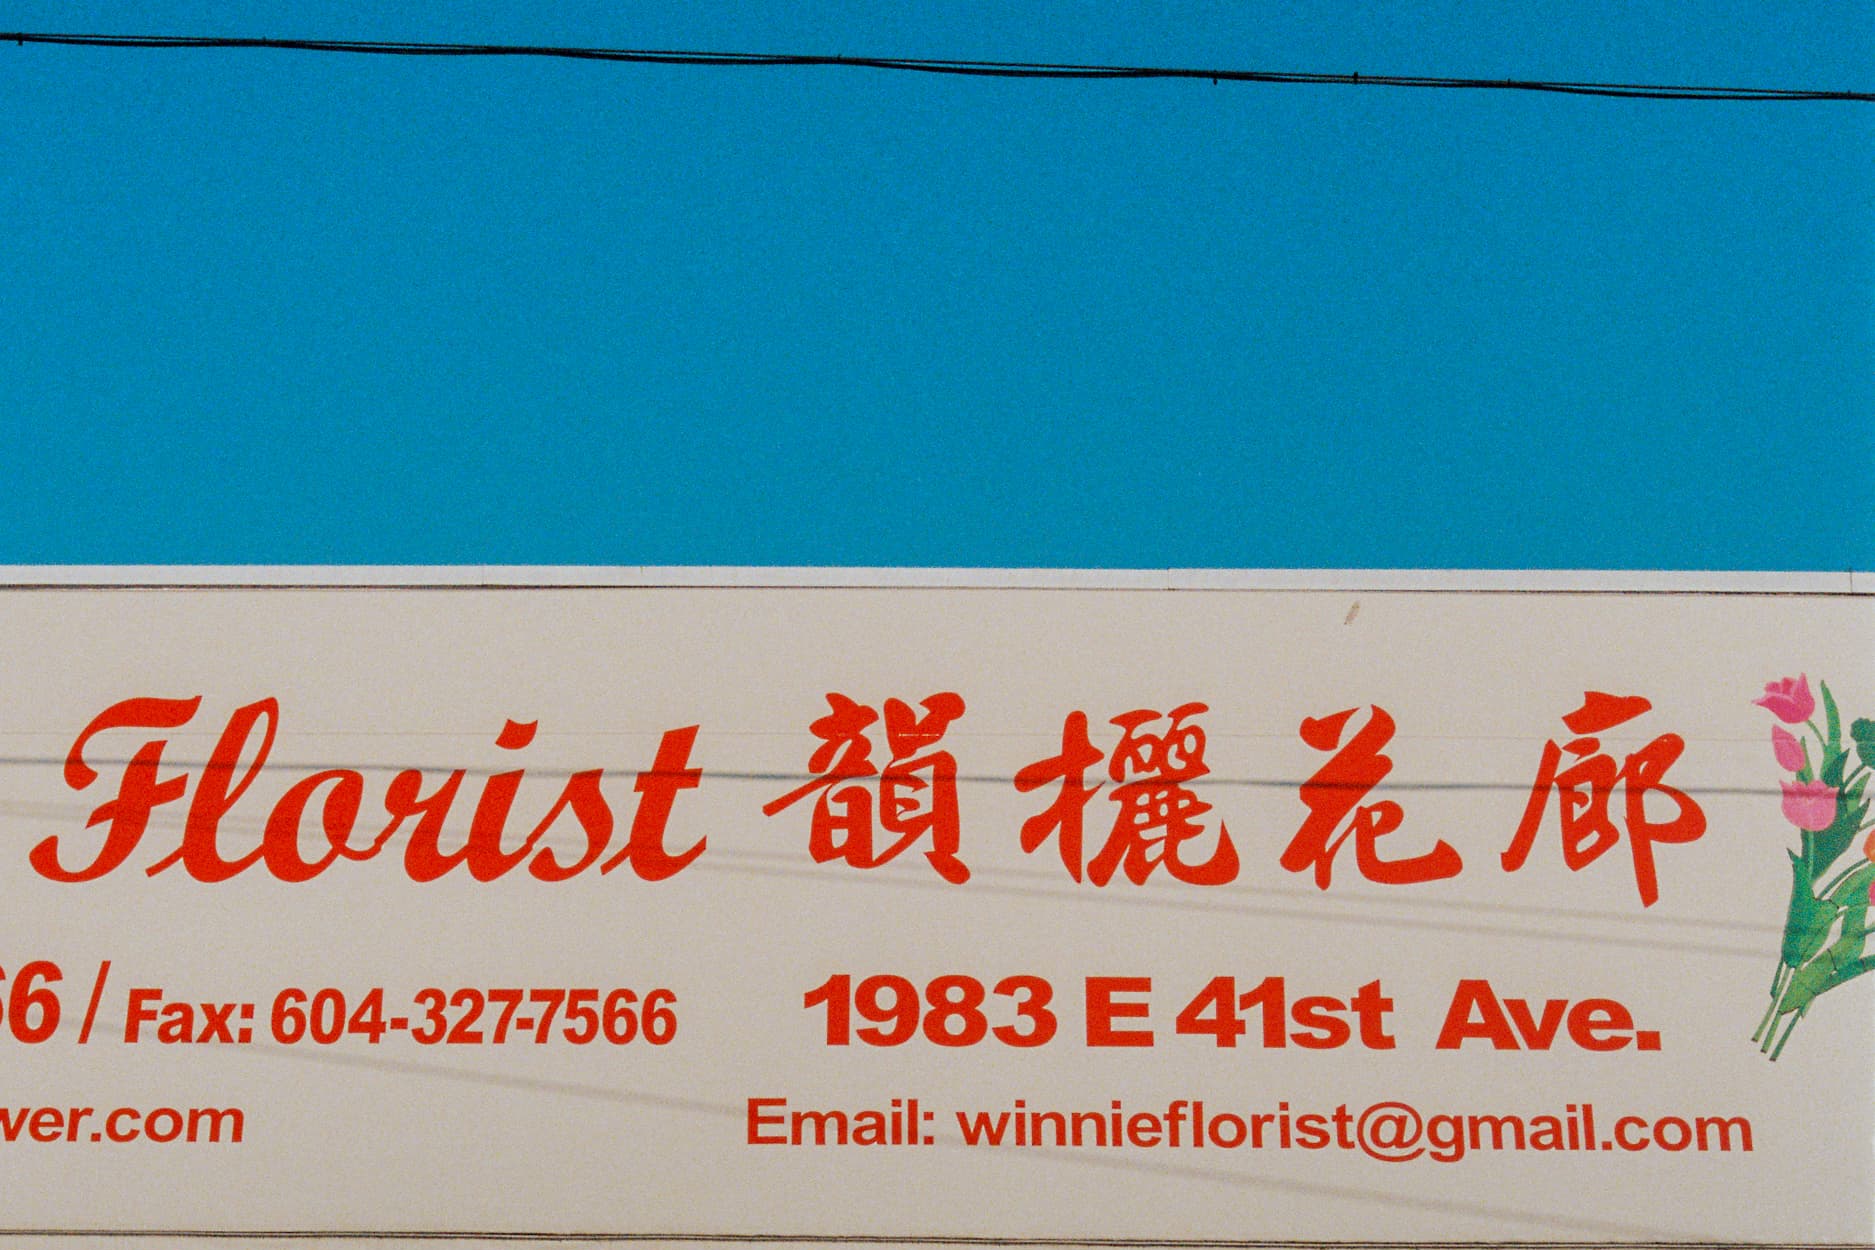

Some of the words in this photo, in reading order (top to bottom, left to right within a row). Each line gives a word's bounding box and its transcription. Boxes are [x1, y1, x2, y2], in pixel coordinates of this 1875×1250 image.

[28, 695, 707, 884] Florist
[0, 959, 64, 1045] 6
[123, 988, 255, 1045] Fax:
[270, 987, 678, 1046] 604-327-7566
[803, 973, 1058, 1048] 1983
[1085, 976, 1155, 1048] E
[1175, 975, 1396, 1051] 41st
[1435, 979, 1662, 1052] Ave.
[747, 1097, 935, 1147] Email:
[956, 1099, 1753, 1163] winnieflorist@gmail.com
